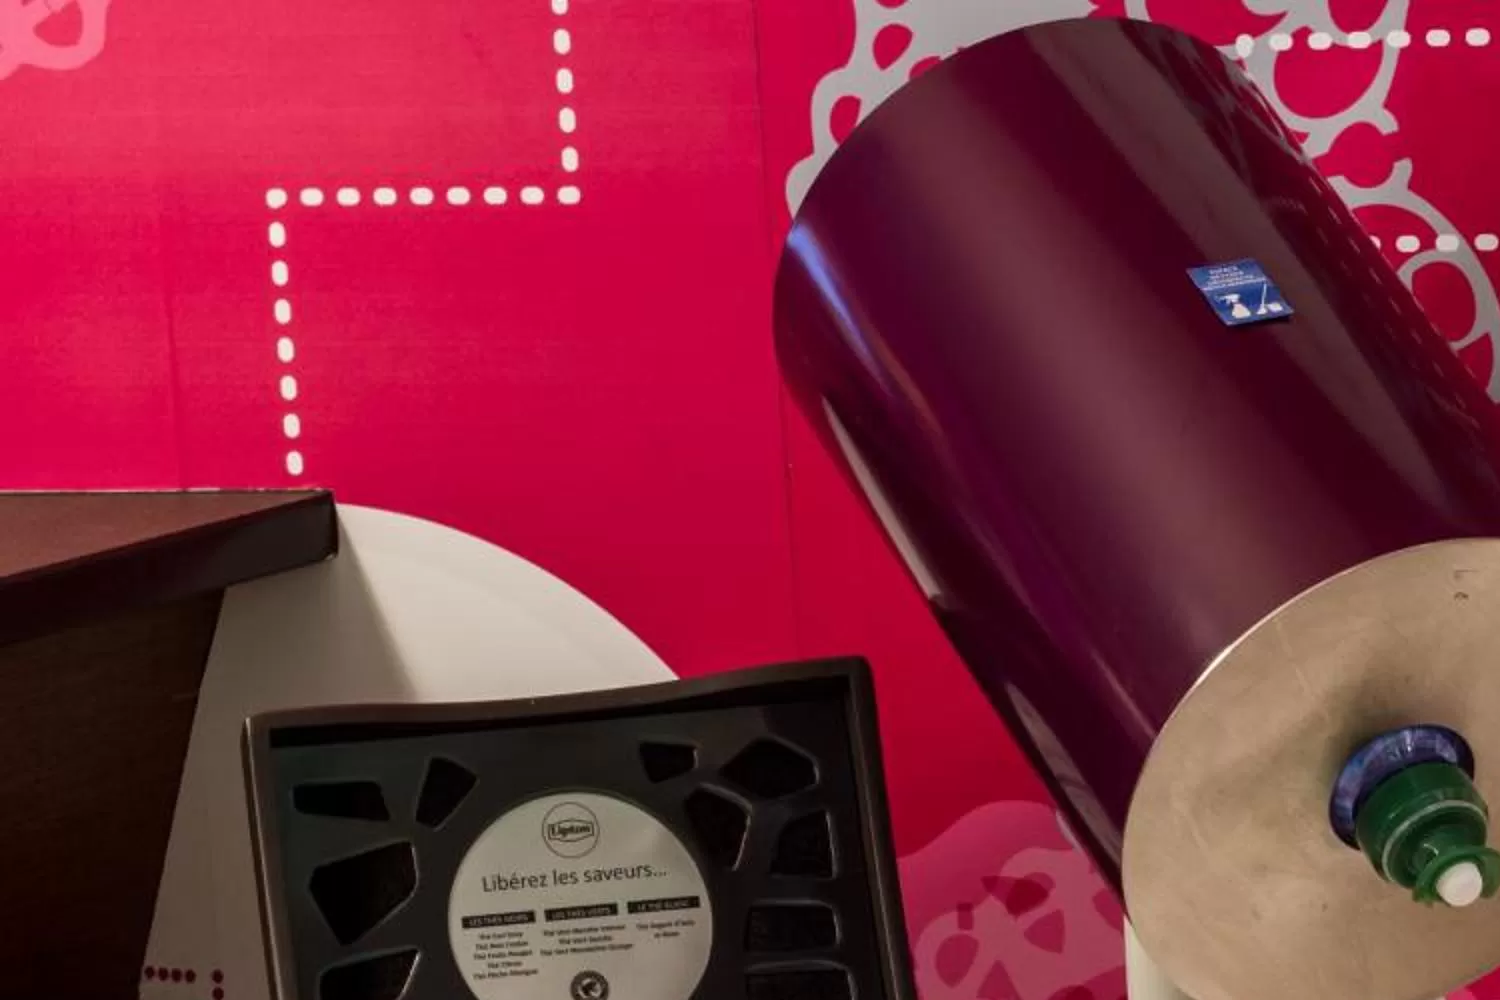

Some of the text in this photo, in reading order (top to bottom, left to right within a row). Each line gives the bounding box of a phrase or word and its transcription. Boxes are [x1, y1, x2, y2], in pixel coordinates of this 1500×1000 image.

[481, 864, 668, 893] Libérez les saveurs...
